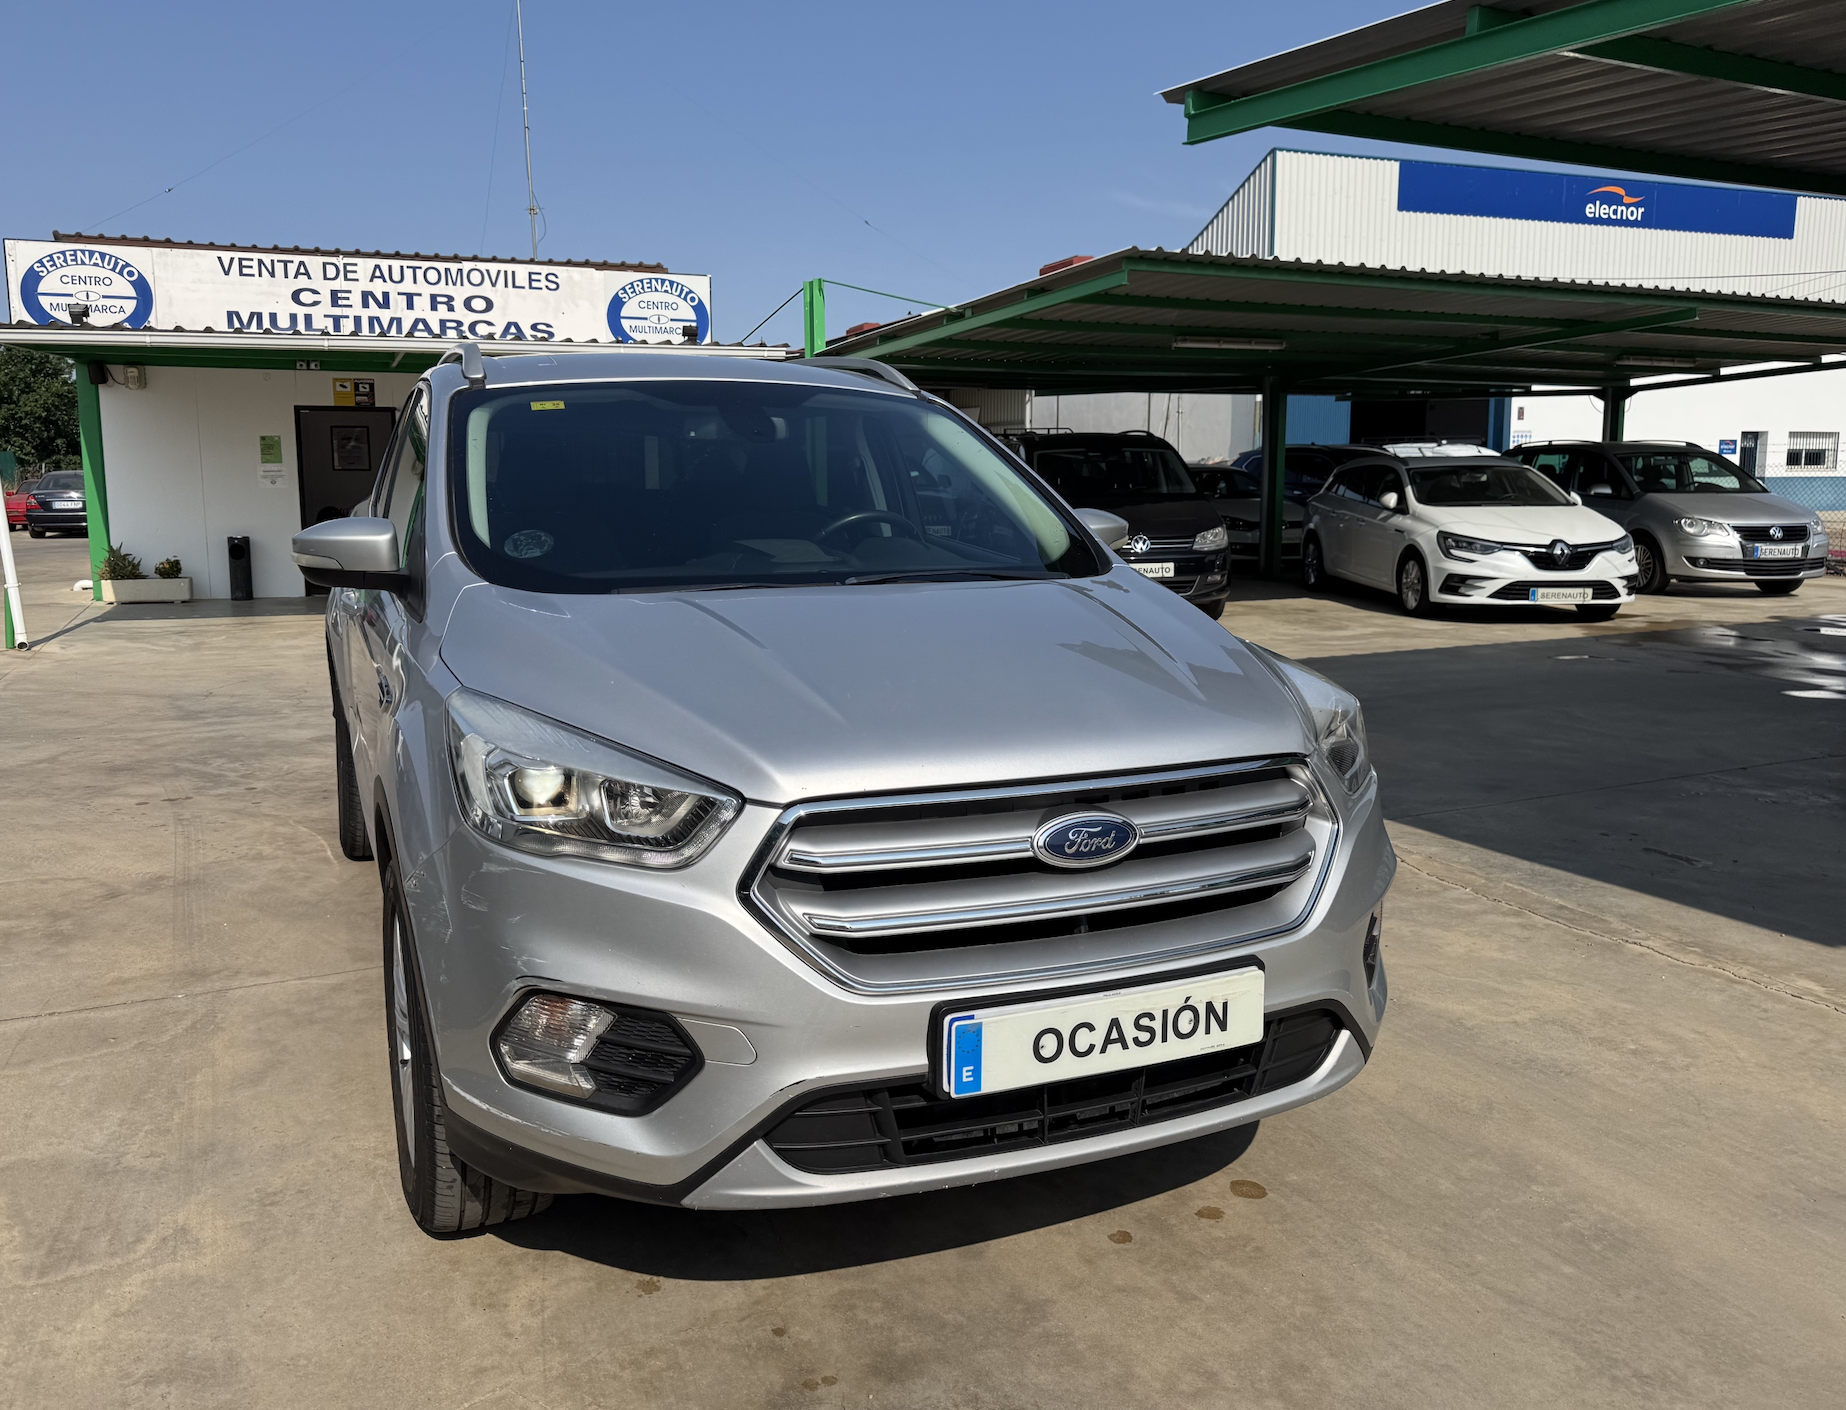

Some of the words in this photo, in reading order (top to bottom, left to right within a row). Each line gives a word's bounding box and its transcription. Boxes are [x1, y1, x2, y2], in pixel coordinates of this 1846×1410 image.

[1585, 200, 1645, 221] elecnor
[33, 250, 139, 281] SERENAUTO
[216, 256, 312, 280] VENTA
[322, 261, 359, 282] DE
[369, 264, 560, 291] AUTOMOVILES
[60, 274, 113, 287] CENTRO
[291, 287, 494, 314] CENTRO
[617, 279, 699, 306] SERENAUTO
[49, 302, 127, 315] MUARCA
[638, 300, 679, 311] CENTRO
[226, 310, 556, 340] MULTIMARCAS
[629, 325, 682, 336] MULTIMARC
[1760, 547, 1800, 556] SERENAUTO
[1540, 592, 1589, 600] SERENAUTO
[1064, 826, 1116, 854] Ford
[1032, 995, 1229, 1064] OCASIÓN
[962, 1065, 974, 1082] E
